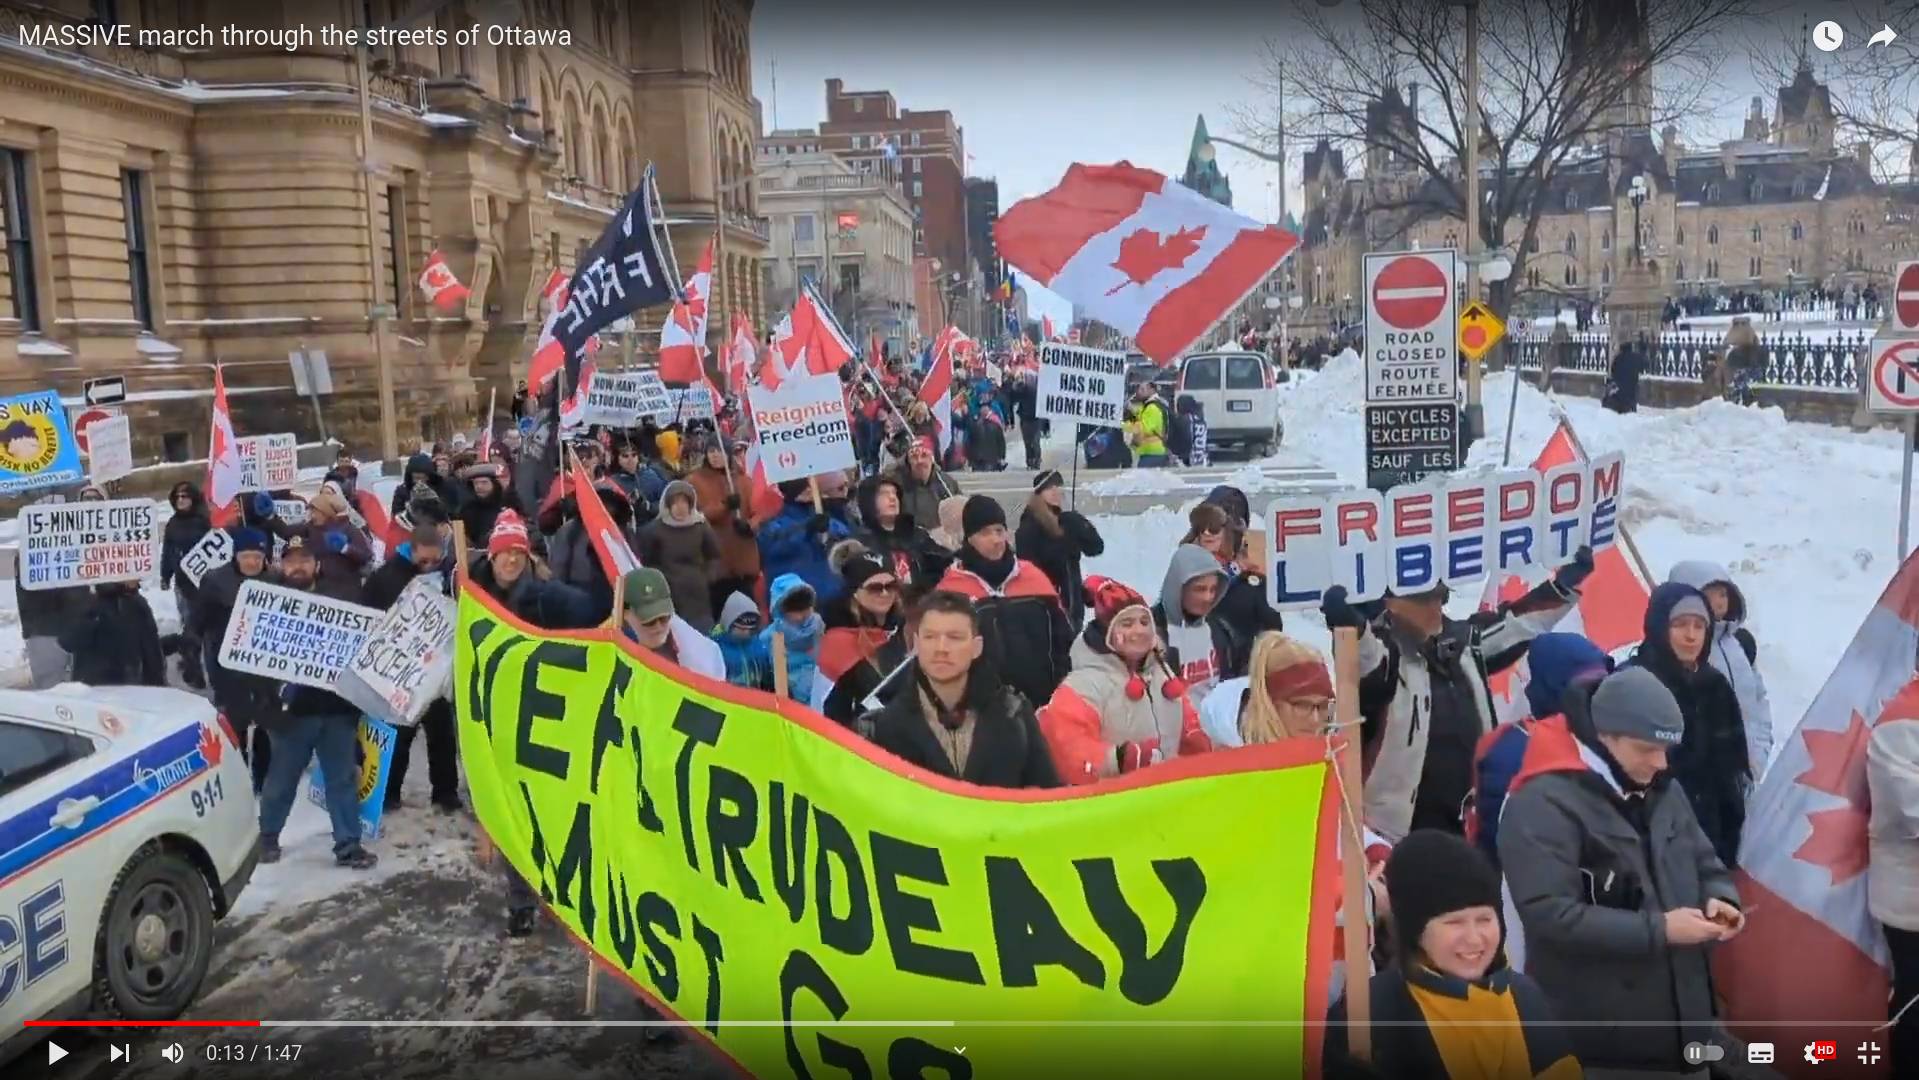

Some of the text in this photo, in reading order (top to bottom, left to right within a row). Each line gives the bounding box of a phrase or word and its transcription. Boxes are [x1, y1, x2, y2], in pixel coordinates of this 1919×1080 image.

[1385, 331, 1434, 345] ROAD
[1042, 346, 1124, 375] COMMUNISM
[1376, 347, 1447, 362] CLOSED
[1060, 373, 1106, 396] HAS NO
[1381, 367, 1440, 380] ROUTE
[1375, 381, 1448, 397] FERMÉE
[20, 397, 54, 416] VAX
[756, 400, 842, 426] Reignite
[1046, 395, 1082, 416] HOME
[1371, 408, 1451, 425] BICYCLES
[759, 419, 848, 445] Freedom
[816, 432, 849, 446] .com
[1371, 427, 1450, 444] EXCEPTED
[1372, 452, 1452, 469] SAUF LES
[1275, 459, 1622, 553] FREEDOM
[27, 506, 151, 535] 15-MINUTE CITIES
[28, 534, 74, 550] DIGITAL
[125, 528, 151, 542] $$$
[28, 552, 49, 566] NOT
[54, 552, 62, 564] 4
[84, 545, 151, 561] CONVENIENCE
[29, 559, 152, 583] BUT TO CONTROL US
[245, 588, 373, 633] WHY WE PROTEST
[399, 591, 456, 647] SHOW
[253, 625, 326, 651] CHILDREN'S
[257, 612, 327, 638] FREEDOM
[327, 627, 350, 643] FOR
[227, 648, 263, 668] WHY
[267, 657, 288, 672] DO
[294, 661, 323, 680] YOU
[250, 637, 281, 655] VAX
[280, 646, 345, 669] JUSTICE
[366, 722, 390, 752] VAX
[672, 697, 1207, 1006] TRUDEAU
[518, 780, 725, 1035] MUST
